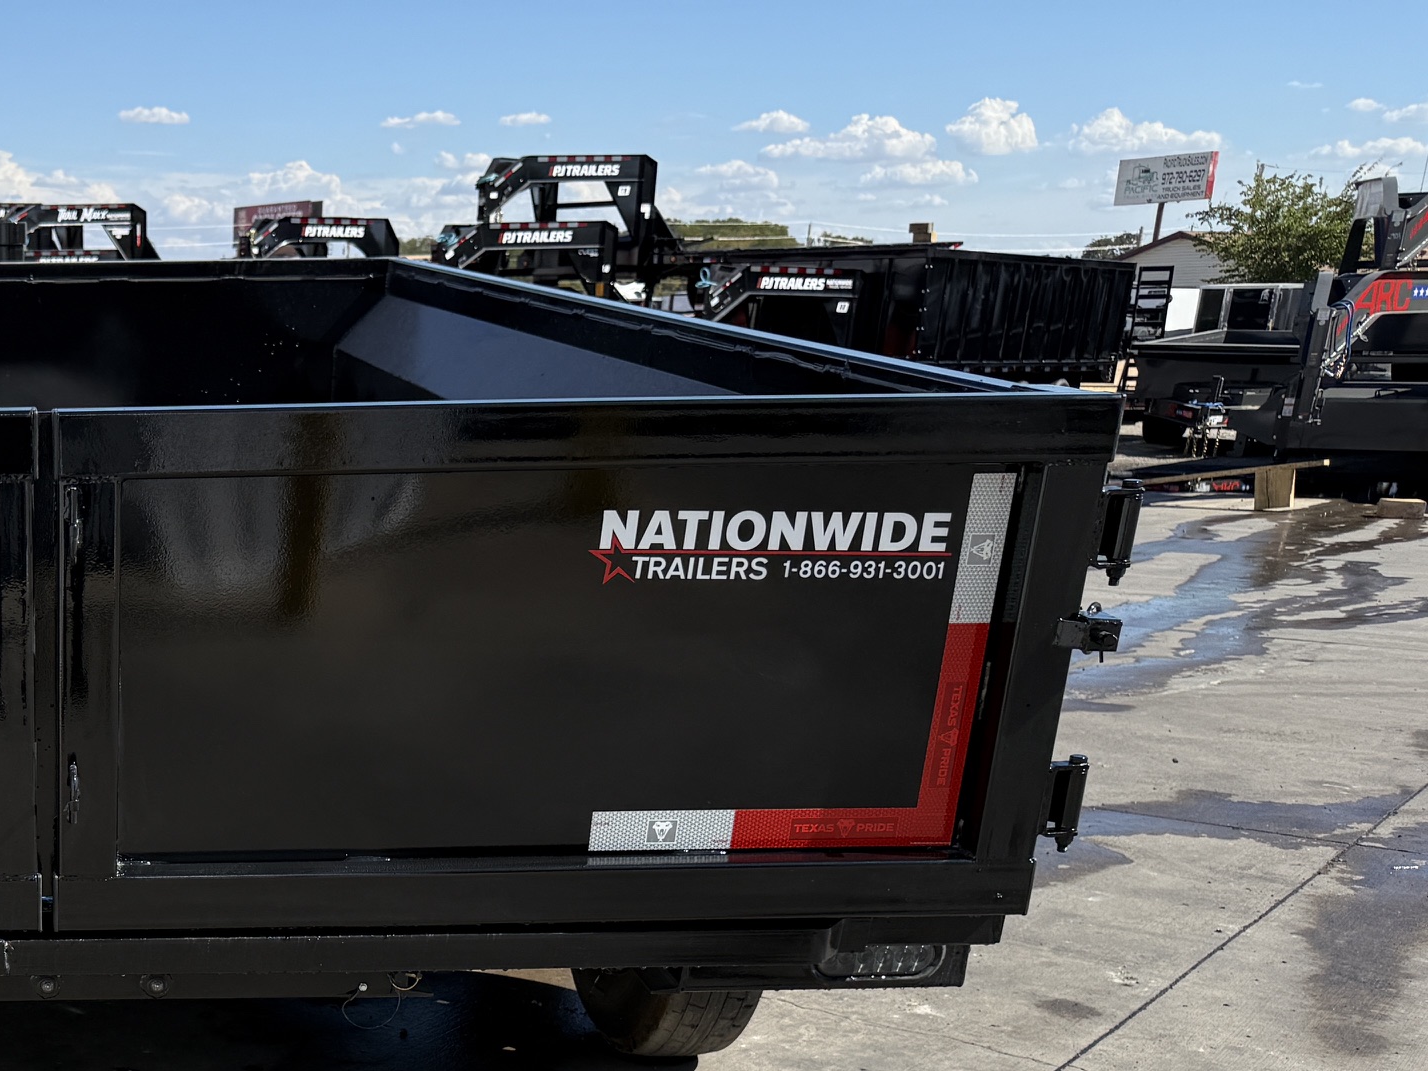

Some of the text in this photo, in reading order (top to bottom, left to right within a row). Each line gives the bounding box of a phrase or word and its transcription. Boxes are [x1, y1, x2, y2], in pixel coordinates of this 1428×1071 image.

[1124, 184, 1158, 194] PACIFIC
[1355, 279, 1412, 315] ARC
[599, 510, 952, 552] NATIONWIDE
[631, 556, 945, 580] TRAILERS 1-866-931-3001
[936, 685, 963, 787] TEXAS PRIDE
[794, 823, 894, 833] TEXAS PRIDE
